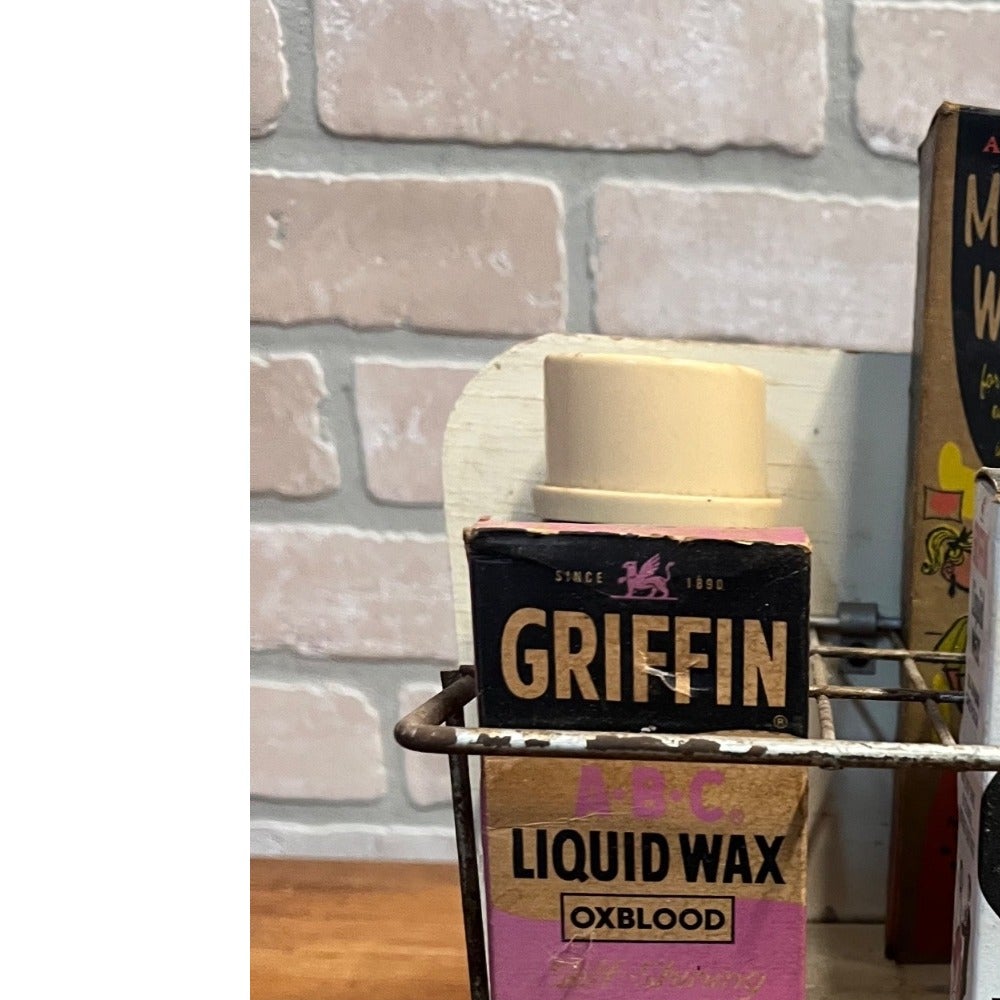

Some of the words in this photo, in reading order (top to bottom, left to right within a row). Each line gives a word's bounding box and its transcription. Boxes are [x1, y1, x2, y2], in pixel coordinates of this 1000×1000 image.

[554, 569, 604, 584] SINCE
[686, 575, 724, 591] 1890
[501, 607, 788, 707] GRIFFIN
[512, 828, 670, 883] LIQUID
[678, 833, 787, 884] WAX
[570, 906, 727, 931] OXBLOOD
